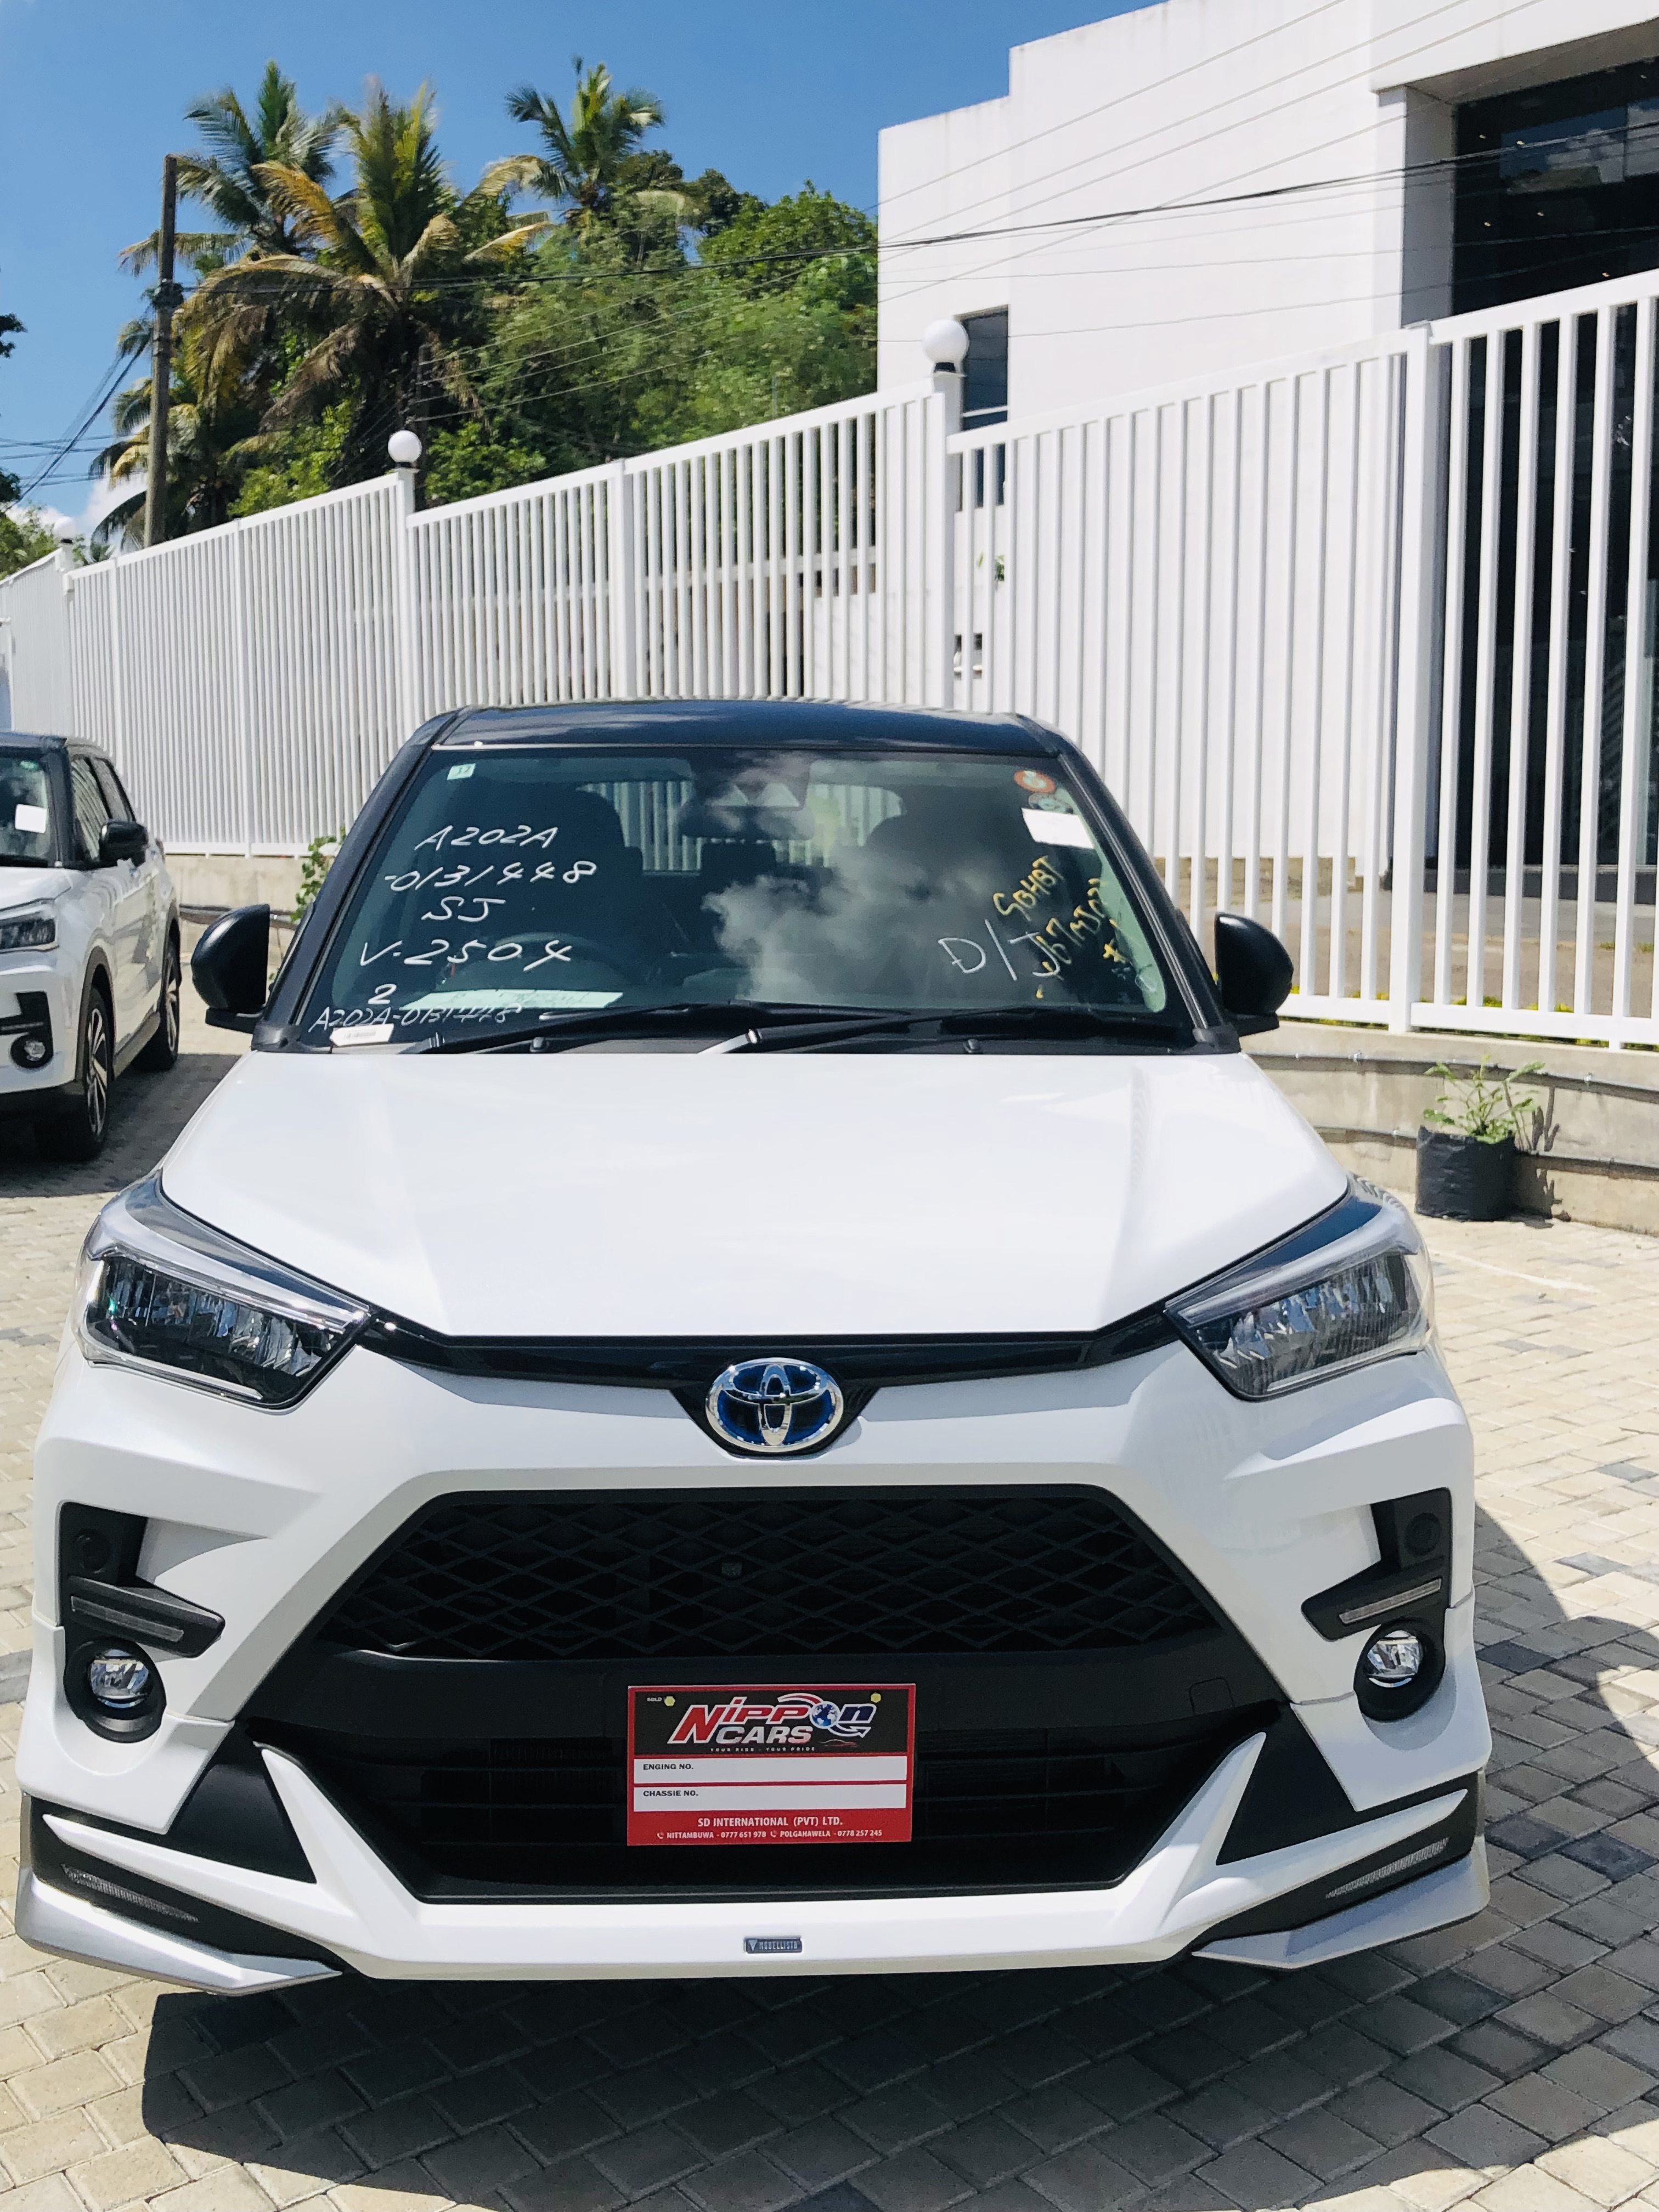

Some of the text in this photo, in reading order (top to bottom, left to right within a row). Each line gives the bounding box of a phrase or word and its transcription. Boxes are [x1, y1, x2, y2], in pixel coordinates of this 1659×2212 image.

[414, 825, 559, 851] A202A
[421, 896, 506, 923] SJ
[368, 983, 397, 1005] 2
[715, 1725, 813, 1745] CARS
[697, 1816, 843, 1827] SD INTERNATIONAL (PVT) LTD.
